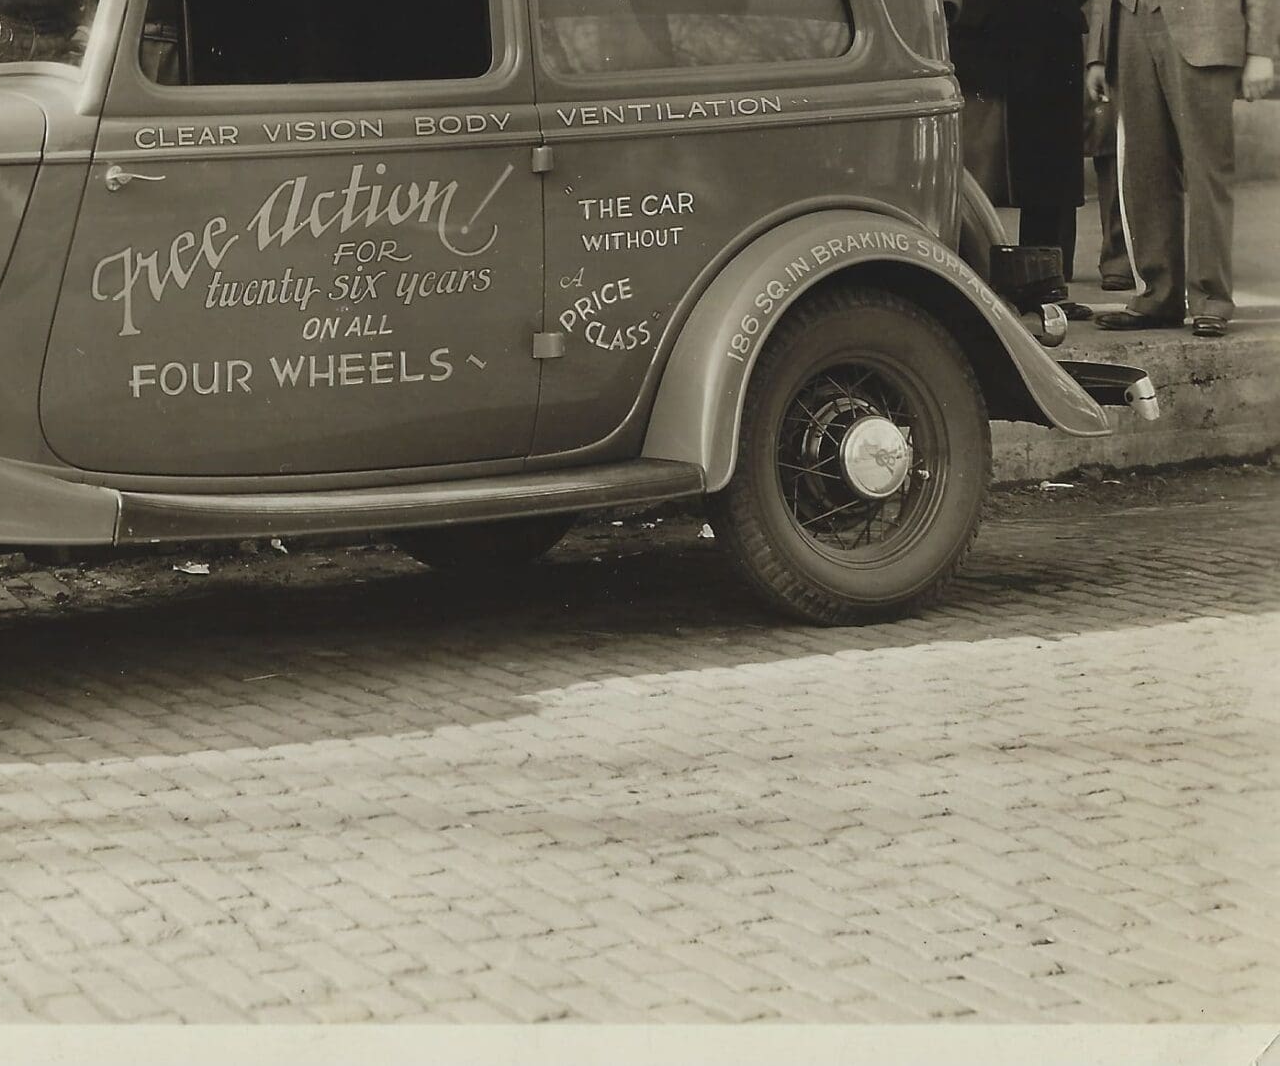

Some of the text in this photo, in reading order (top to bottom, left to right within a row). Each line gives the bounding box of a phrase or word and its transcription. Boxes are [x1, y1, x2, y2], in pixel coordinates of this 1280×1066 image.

[135, 95, 782, 148] CLEAR VISION BODY VENTILATION
[640, 192, 695, 216] CAR
[333, 240, 413, 265] FOR
[581, 227, 684, 252] WITHOUT
[204, 265, 492, 310] twenty six years
[559, 278, 633, 333] PRICE
[727, 314, 760, 362] 186
[810, 232, 911, 265] BRAKING
[915, 240, 1004, 322] SURFACE
[302, 313, 394, 340] ON ALL
[128, 348, 454, 398] FOUR WHEELS
